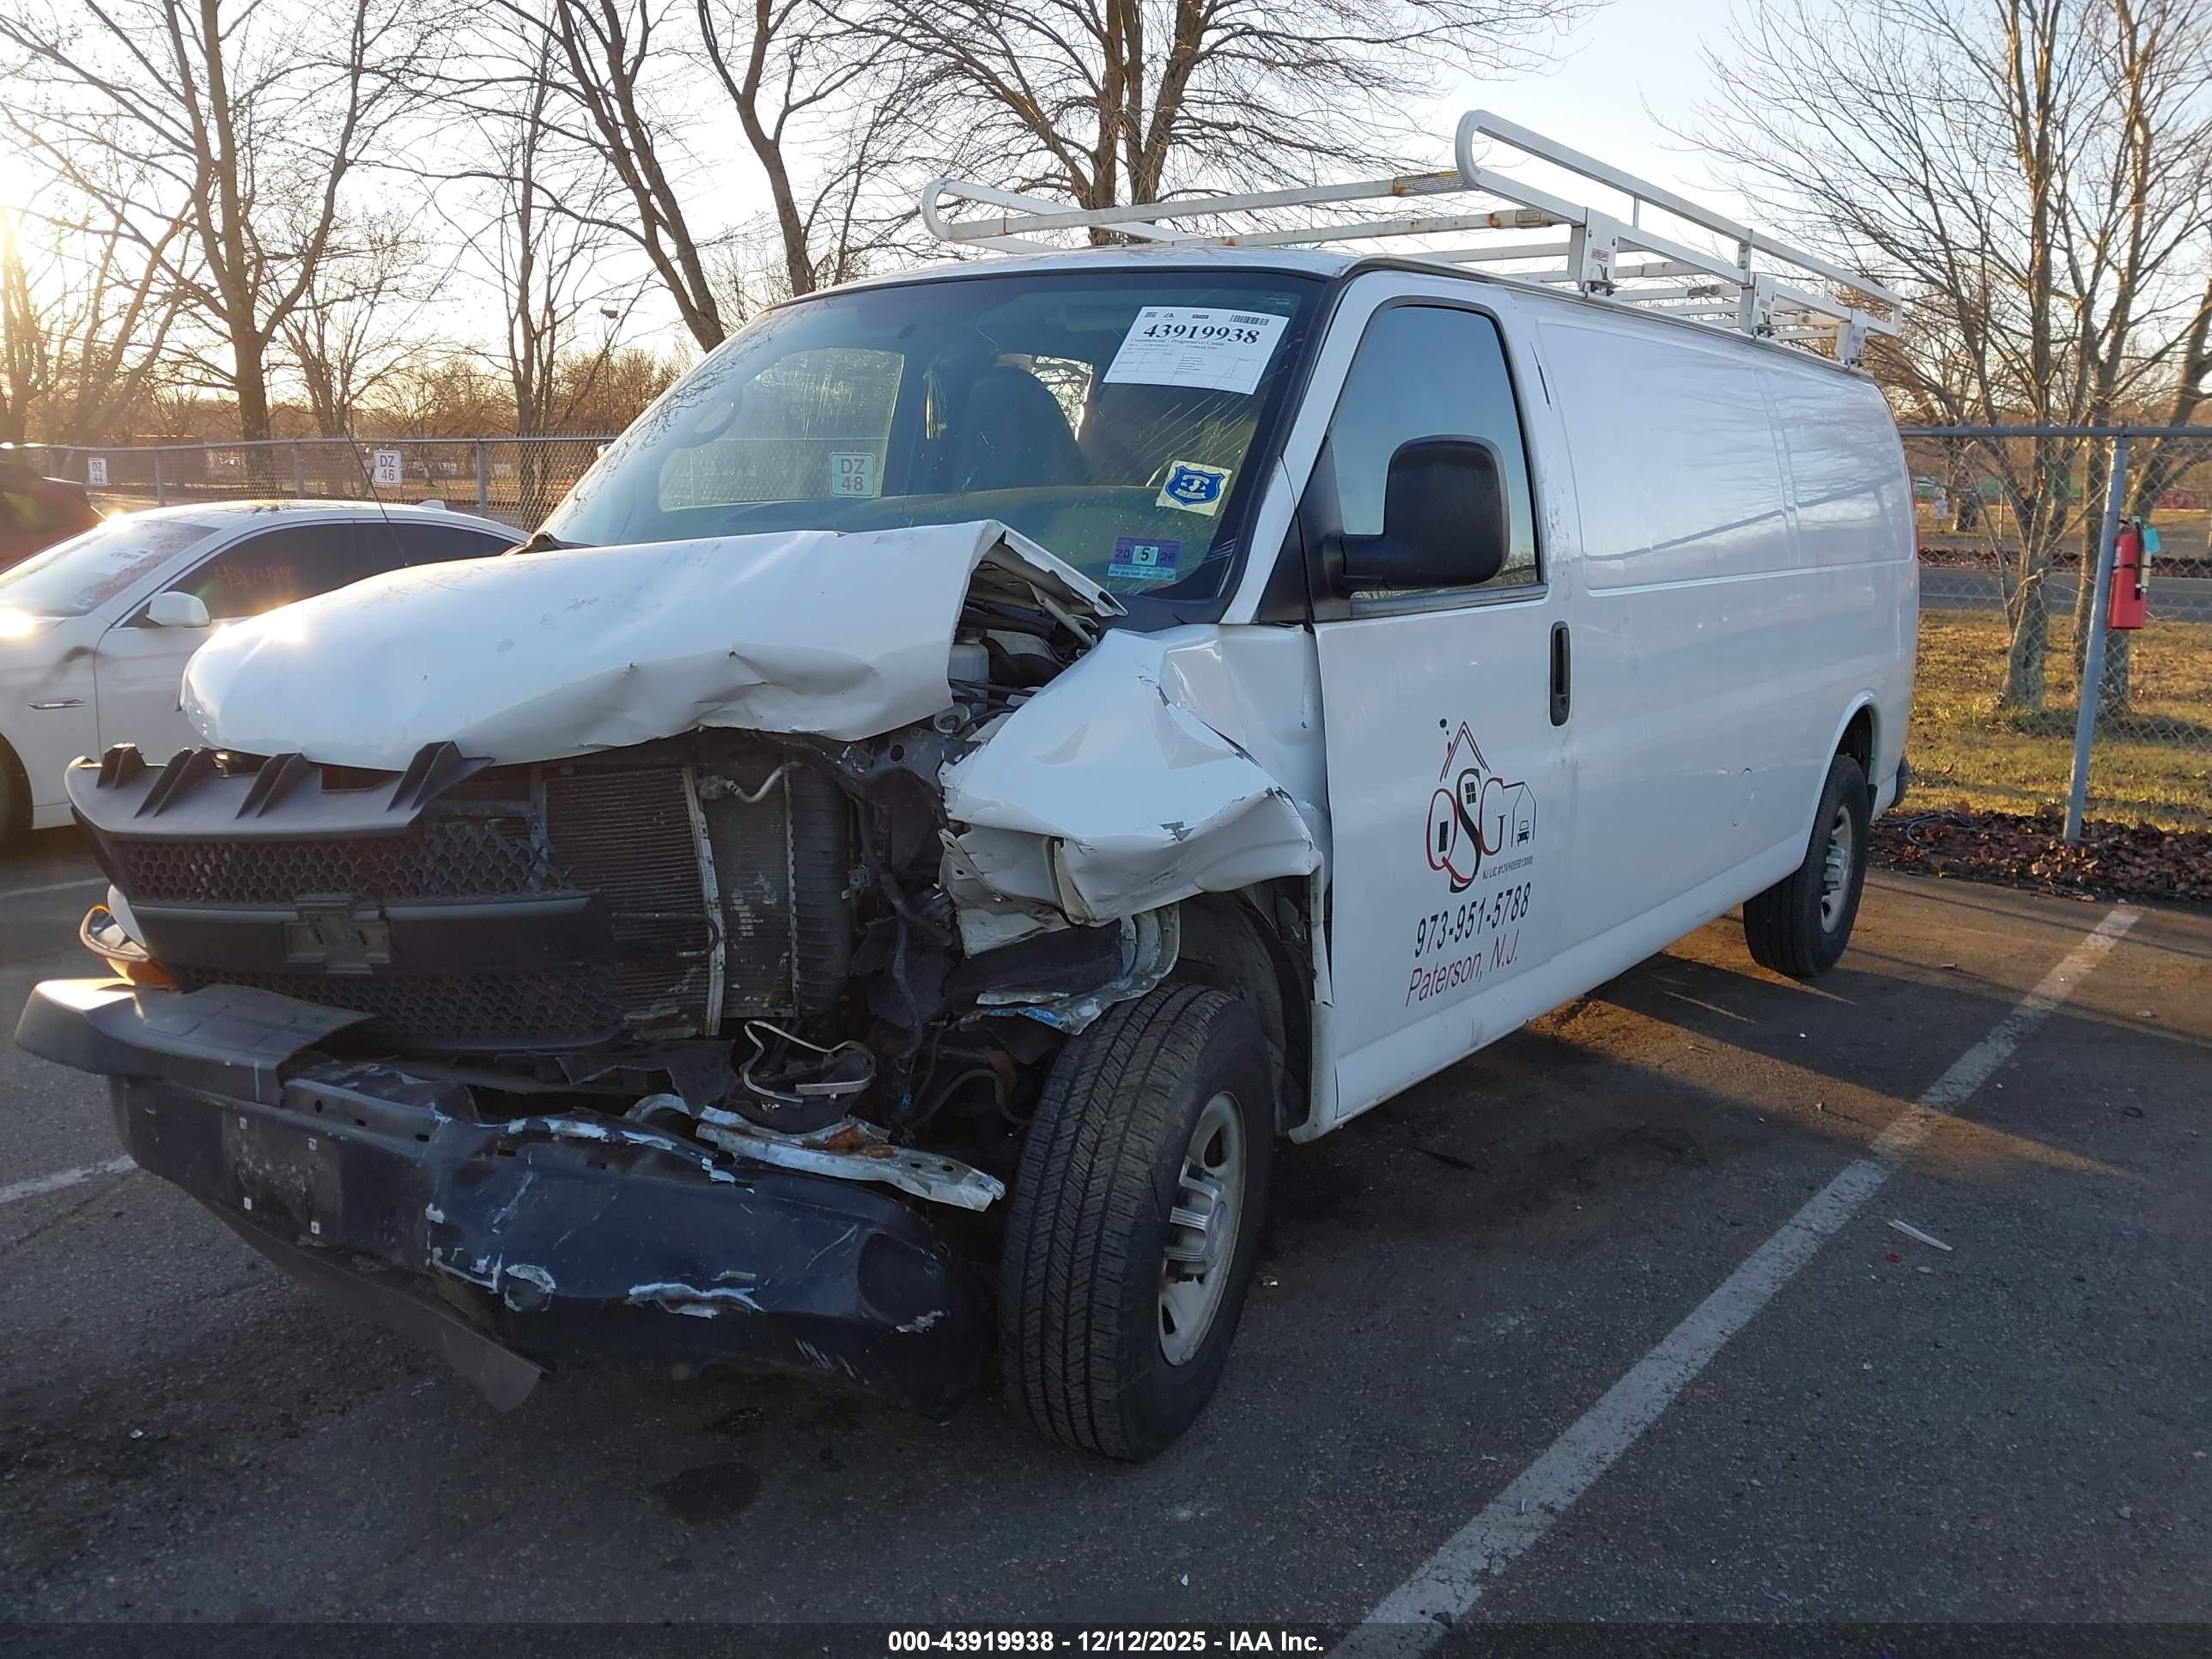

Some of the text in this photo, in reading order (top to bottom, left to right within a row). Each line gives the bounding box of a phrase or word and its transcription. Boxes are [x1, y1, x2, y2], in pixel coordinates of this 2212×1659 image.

[1143, 323, 1260, 344] 43919938
[380, 455, 395, 468] DZ
[841, 458, 866, 475] DZ
[381, 469, 395, 481] 46
[842, 476, 864, 492] 48
[1115, 549, 1130, 558] 20
[1139, 547, 1151, 562] 5
[1426, 768, 1507, 894] QSG
[1414, 881, 1531, 958] 973-951-5788
[1405, 928, 1520, 1008] Paterson, N.J.
